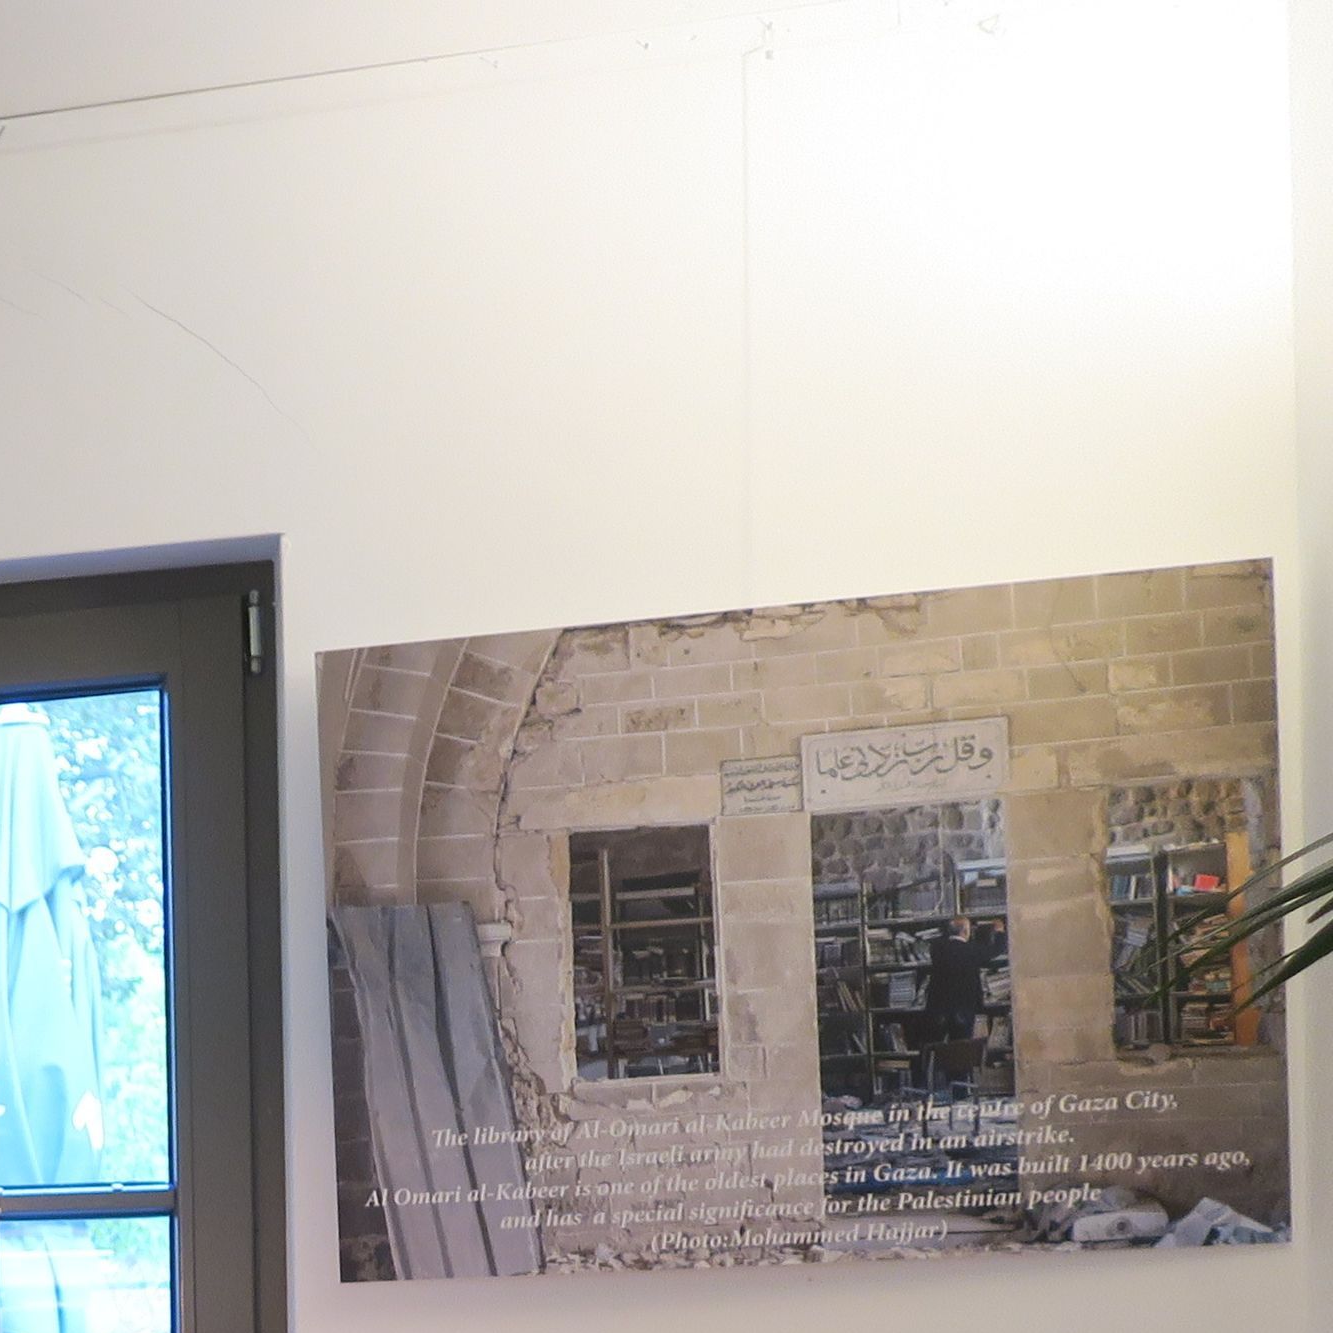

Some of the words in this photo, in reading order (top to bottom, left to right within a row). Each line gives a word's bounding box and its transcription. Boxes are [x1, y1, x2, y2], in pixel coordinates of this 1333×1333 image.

[433, 1127, 469, 1149] The
[473, 1123, 546, 1149] library
[550, 1120, 572, 1148] of
[575, 1115, 680, 1141] Al-Omari
[685, 1111, 791, 1134] al-Kabeer
[797, 1109, 884, 1131] Mosque
[889, 1101, 911, 1122] in
[916, 1099, 951, 1121] the
[1030, 1092, 1054, 1118] of
[1059, 1092, 1119, 1114] Gaza
[1125, 1089, 1180, 1112] City,
[524, 1151, 576, 1174] after
[579, 1149, 613, 1169] the
[619, 1144, 686, 1166] Israeli
[690, 1145, 748, 1168] army
[753, 1140, 793, 1159] had
[800, 1136, 905, 1159] destroyed
[911, 1133, 935, 1152] in
[939, 1133, 968, 1149] an
[974, 1125, 1076, 1148] airstrike.
[393, 1184, 462, 1207] Omari
[467, 1180, 567, 1203] al-Kabeer
[574, 1178, 592, 1198] is
[597, 1179, 633, 1198] one
[639, 1173, 662, 1200] of
[666, 1172, 700, 1193] the
[705, 1170, 767, 1192] oldest
[773, 1165, 840, 1190] places
[844, 1164, 867, 1184] in
[873, 1161, 939, 1183] Gaza.
[945, 1159, 966, 1180] It
[971, 1160, 1012, 1178] was
[1019, 1153, 1070, 1176] built
[1078, 1152, 1133, 1174] 1400
[1137, 1150, 1199, 1172] years
[1204, 1149, 1251, 1170] ago,
[500, 1209, 542, 1231] and
[547, 1206, 582, 1227] has
[593, 1209, 606, 1226] a
[611, 1203, 685, 1228] special
[688, 1197, 815, 1224] significance
[820, 1192, 853, 1218] for
[857, 1192, 891, 1213] the
[897, 1187, 1023, 1212] Palestinian
[1028, 1182, 1103, 1210] people
[866, 1219, 949, 1245] Hajjar)
